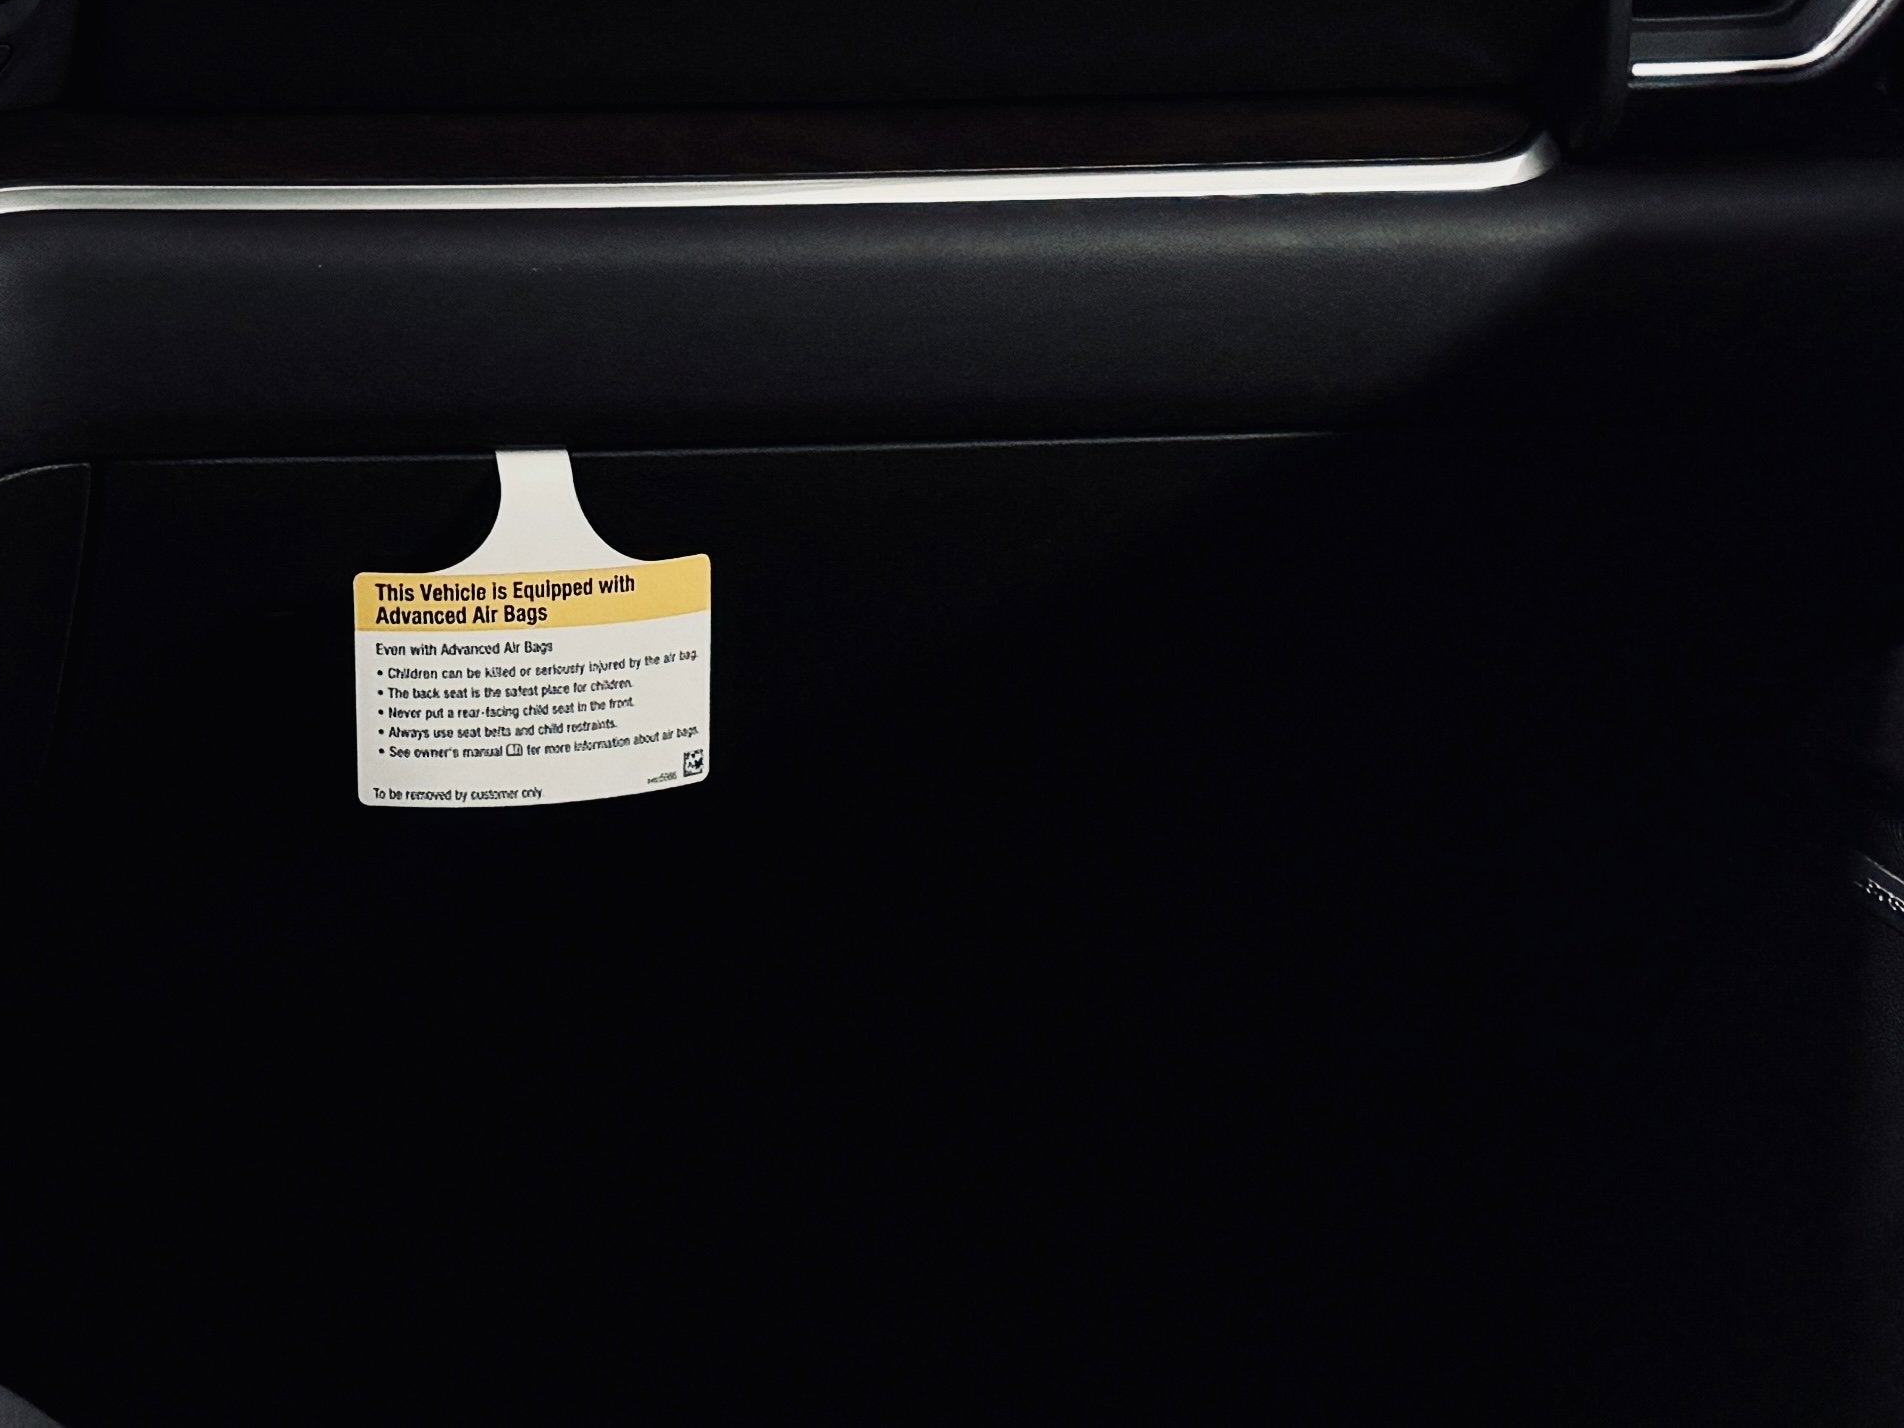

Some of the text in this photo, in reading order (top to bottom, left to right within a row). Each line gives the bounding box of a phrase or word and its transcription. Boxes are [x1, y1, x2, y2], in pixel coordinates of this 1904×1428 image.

[375, 574, 635, 602] This Vehicle is Equipped with
[375, 605, 548, 626] Advanced Air Bags
[376, 641, 553, 656] Even with Advanced Air Bags
[388, 668, 437, 679] Children
[442, 669, 463, 679] can
[467, 668, 481, 679] be
[485, 667, 515, 678] killed
[520, 668, 531, 677] or
[536, 664, 585, 676] seriously
[589, 658, 625, 674] injured
[629, 657, 641, 670] by
[645, 656, 660, 666] the
[664, 652, 676, 663] air
[388, 687, 408, 699] The
[413, 688, 440, 699] back
[444, 688, 468, 699] seat
[471, 687, 480, 698] is
[484, 686, 501, 698] the
[505, 686, 538, 697] safest
[542, 683, 569, 697] place
[574, 682, 587, 693] for
[389, 707, 422, 718] Never
[426, 708, 443, 720] put
[448, 708, 454, 718] a
[458, 706, 519, 719] rear-facing
[523, 704, 548, 716] child
[552, 703, 574, 714] seat
[578, 701, 587, 712] in
[590, 699, 606, 711] the
[389, 727, 430, 740] Always
[434, 728, 453, 738] use
[457, 727, 481, 738] seat
[485, 727, 511, 737] belts
[515, 725, 534, 736] and
[538, 723, 563, 734] child
[389, 746, 410, 758] See
[414, 748, 459, 758] owner's
[463, 746, 502, 757] manual
[527, 744, 541, 755] for
[545, 743, 571, 755] more
[574, 736, 630, 752] information
[634, 731, 660, 745] about
[662, 729, 673, 740] air
[373, 788, 386, 800] To
[389, 788, 403, 800] be
[405, 789, 452, 800] removed
[455, 789, 467, 802] by
[471, 789, 518, 800] customer
